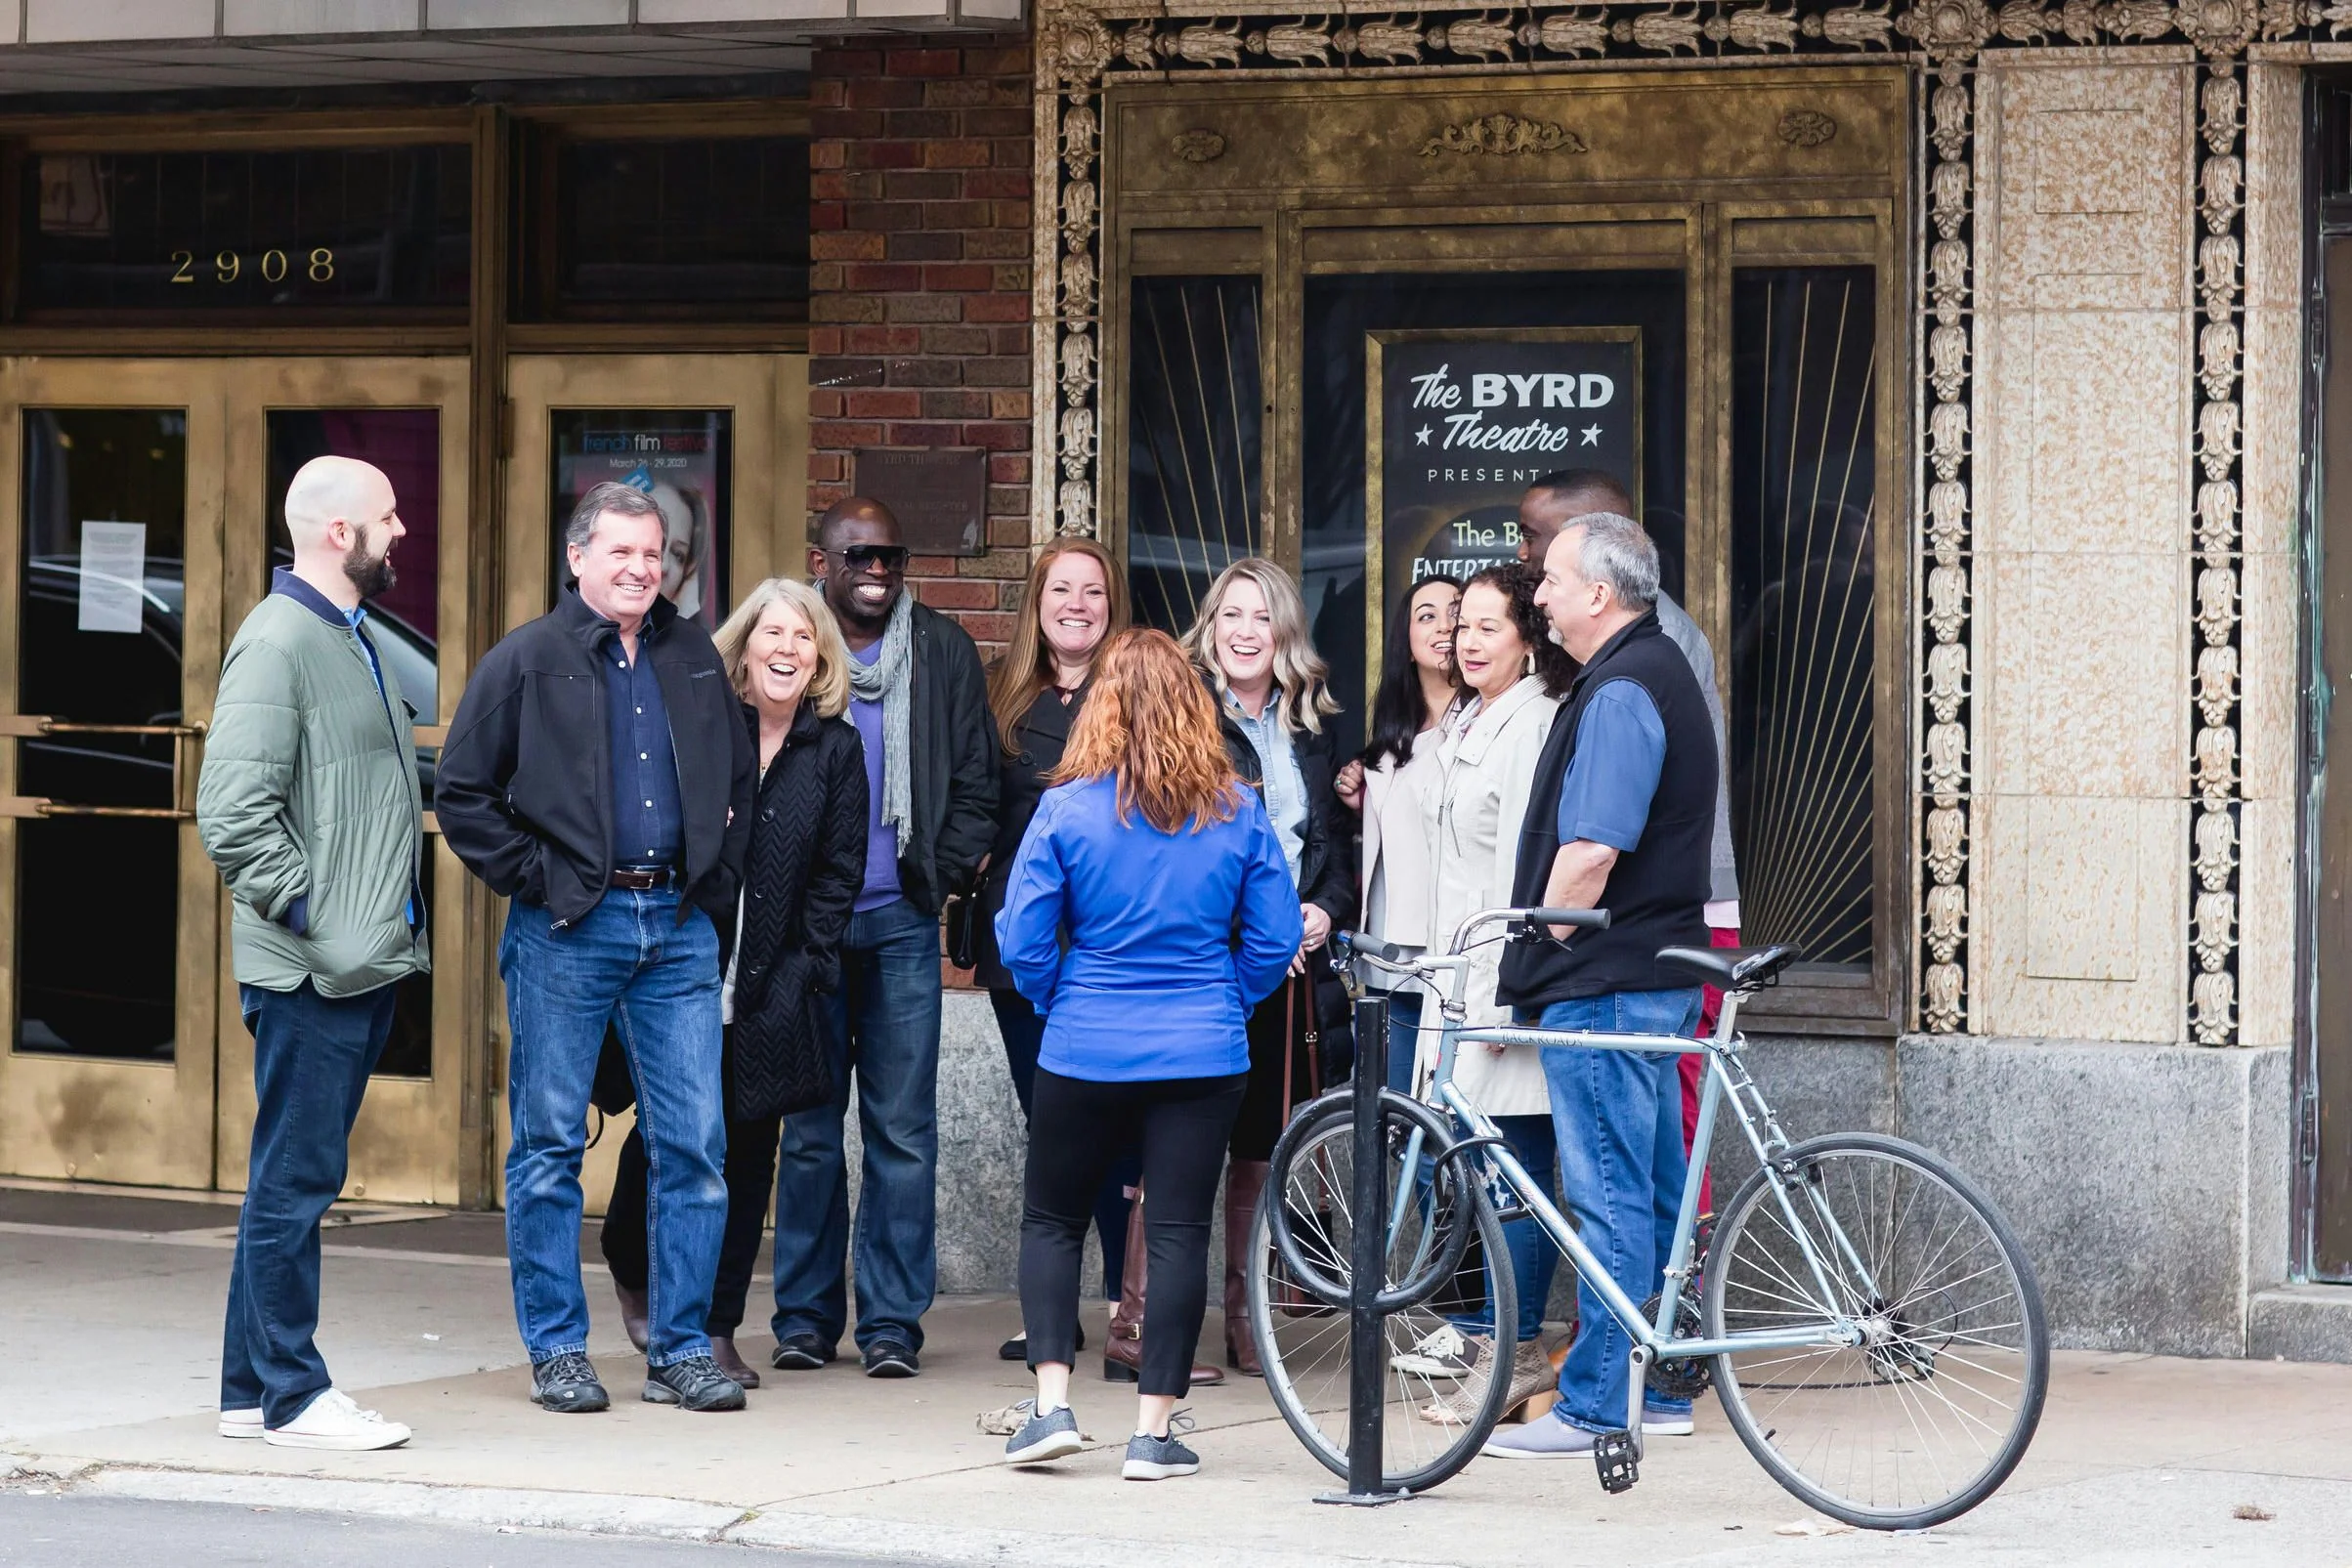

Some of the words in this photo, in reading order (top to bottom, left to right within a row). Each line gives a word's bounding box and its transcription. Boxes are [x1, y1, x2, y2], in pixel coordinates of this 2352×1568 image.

[171, 247, 334, 282] 2908
[1411, 363, 1462, 409] The
[1472, 373, 1614, 408] BYRD
[634, 434, 661, 451] film
[1442, 410, 1569, 452] Theatre
[609, 457, 636, 468] March
[1428, 468, 1553, 482] PRESENT
[1453, 520, 1495, 547] The
